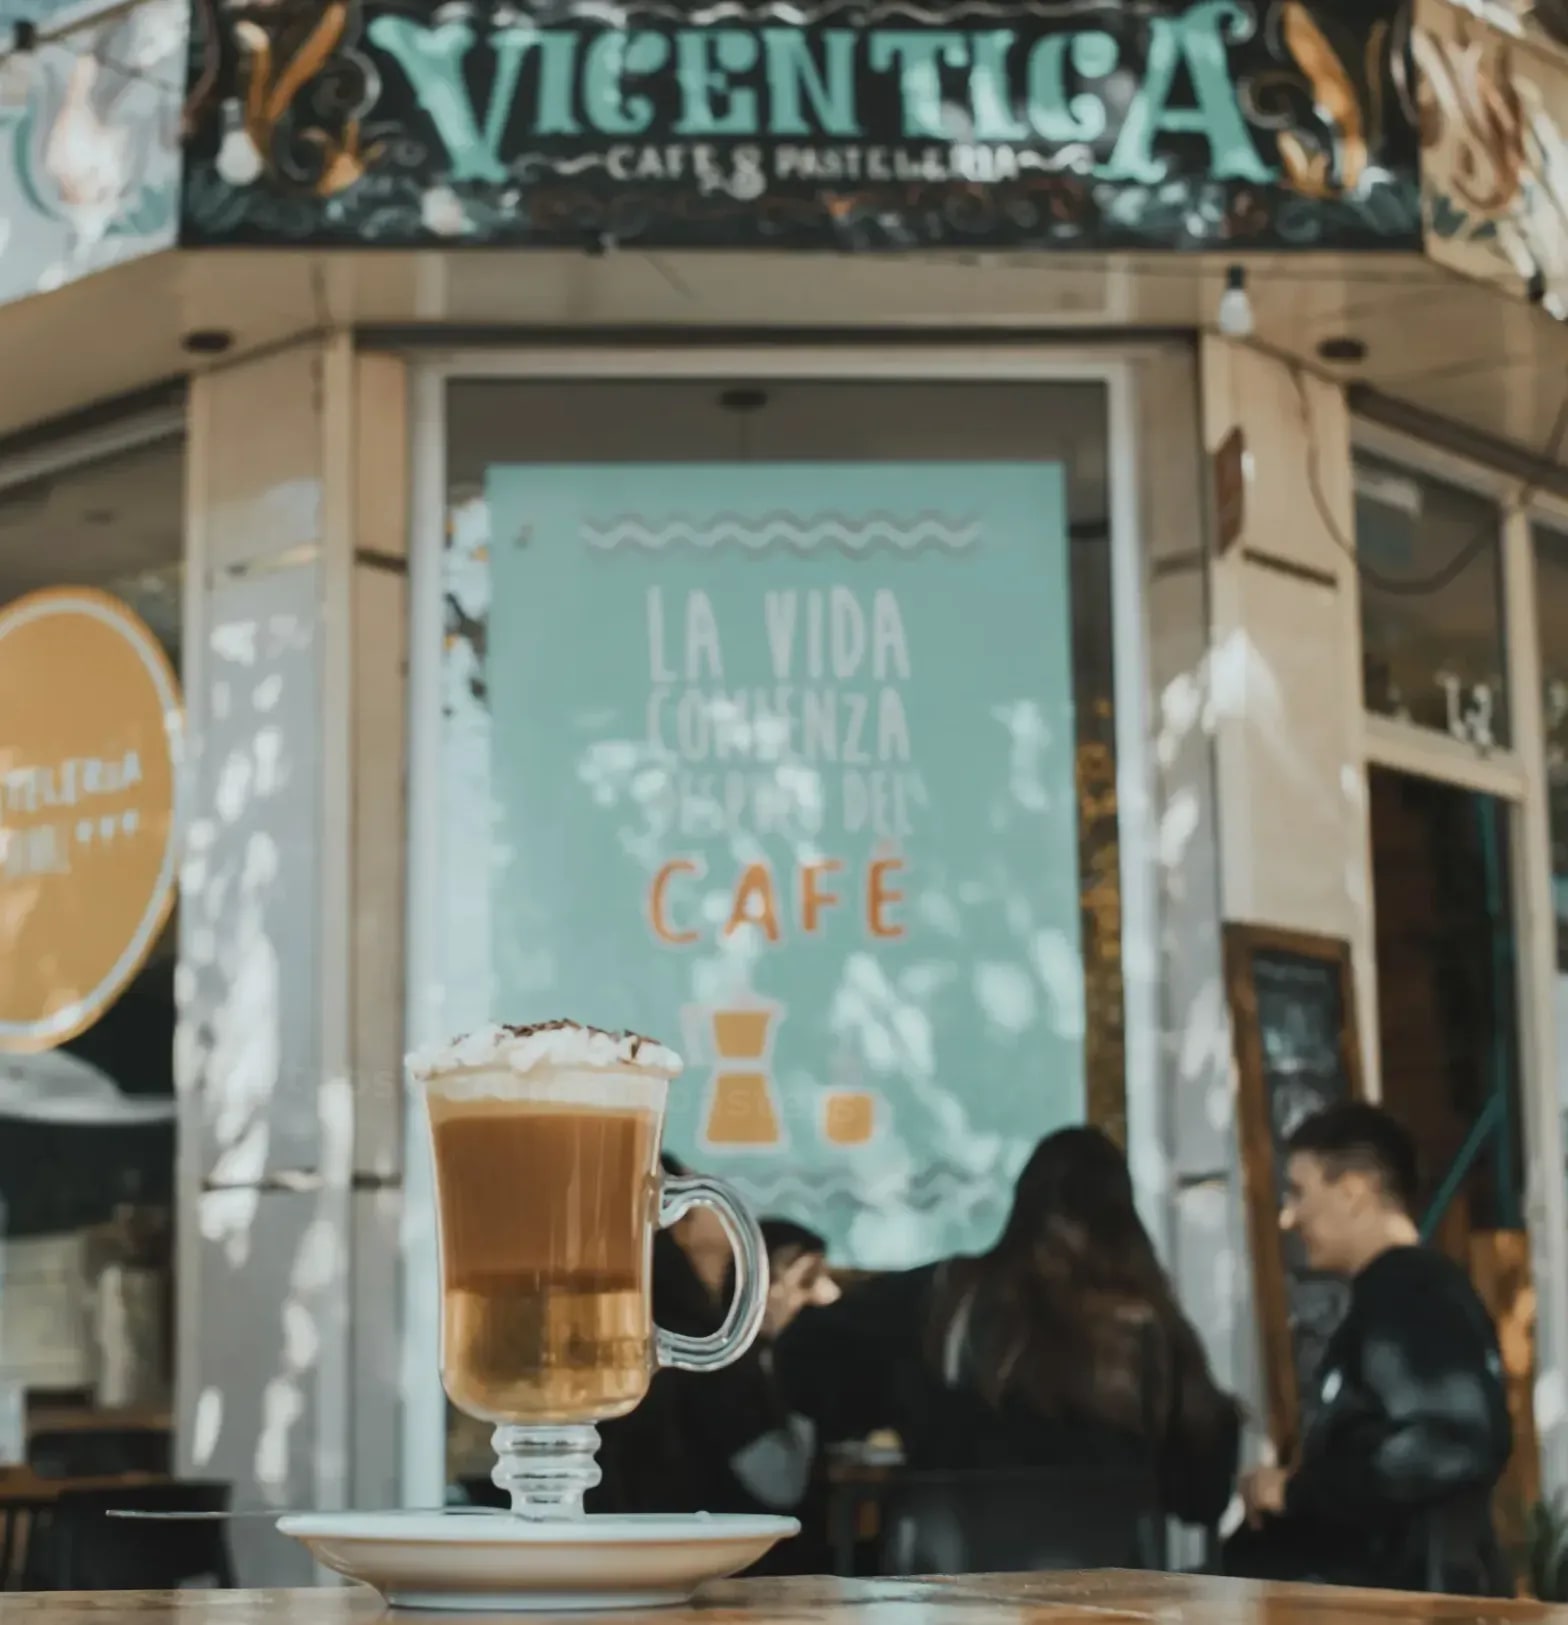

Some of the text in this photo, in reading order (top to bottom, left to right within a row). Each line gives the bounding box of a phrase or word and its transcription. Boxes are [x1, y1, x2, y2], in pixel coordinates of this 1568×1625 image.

[367, 1, 1279, 184] VICENTICA
[645, 584, 911, 683] LA VIDA
[842, 768, 913, 835] DEL
